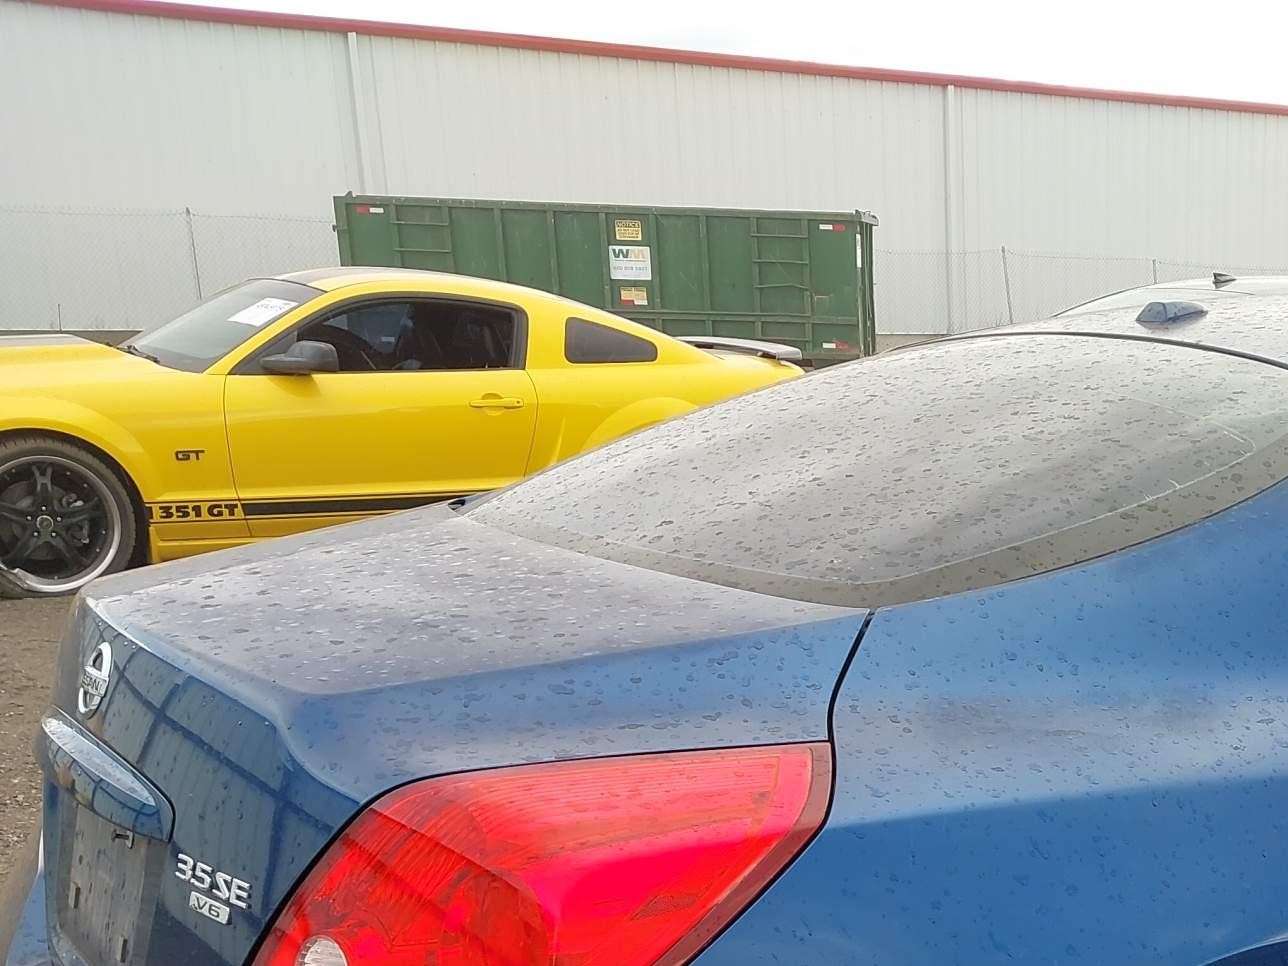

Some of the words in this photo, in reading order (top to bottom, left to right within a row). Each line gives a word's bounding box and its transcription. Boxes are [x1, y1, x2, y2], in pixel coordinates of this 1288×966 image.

[612, 248, 646, 259] WM
[175, 450, 205, 461] GT
[158, 504, 202, 519] 351
[207, 503, 239, 518] GT
[195, 896, 220, 919] V6
